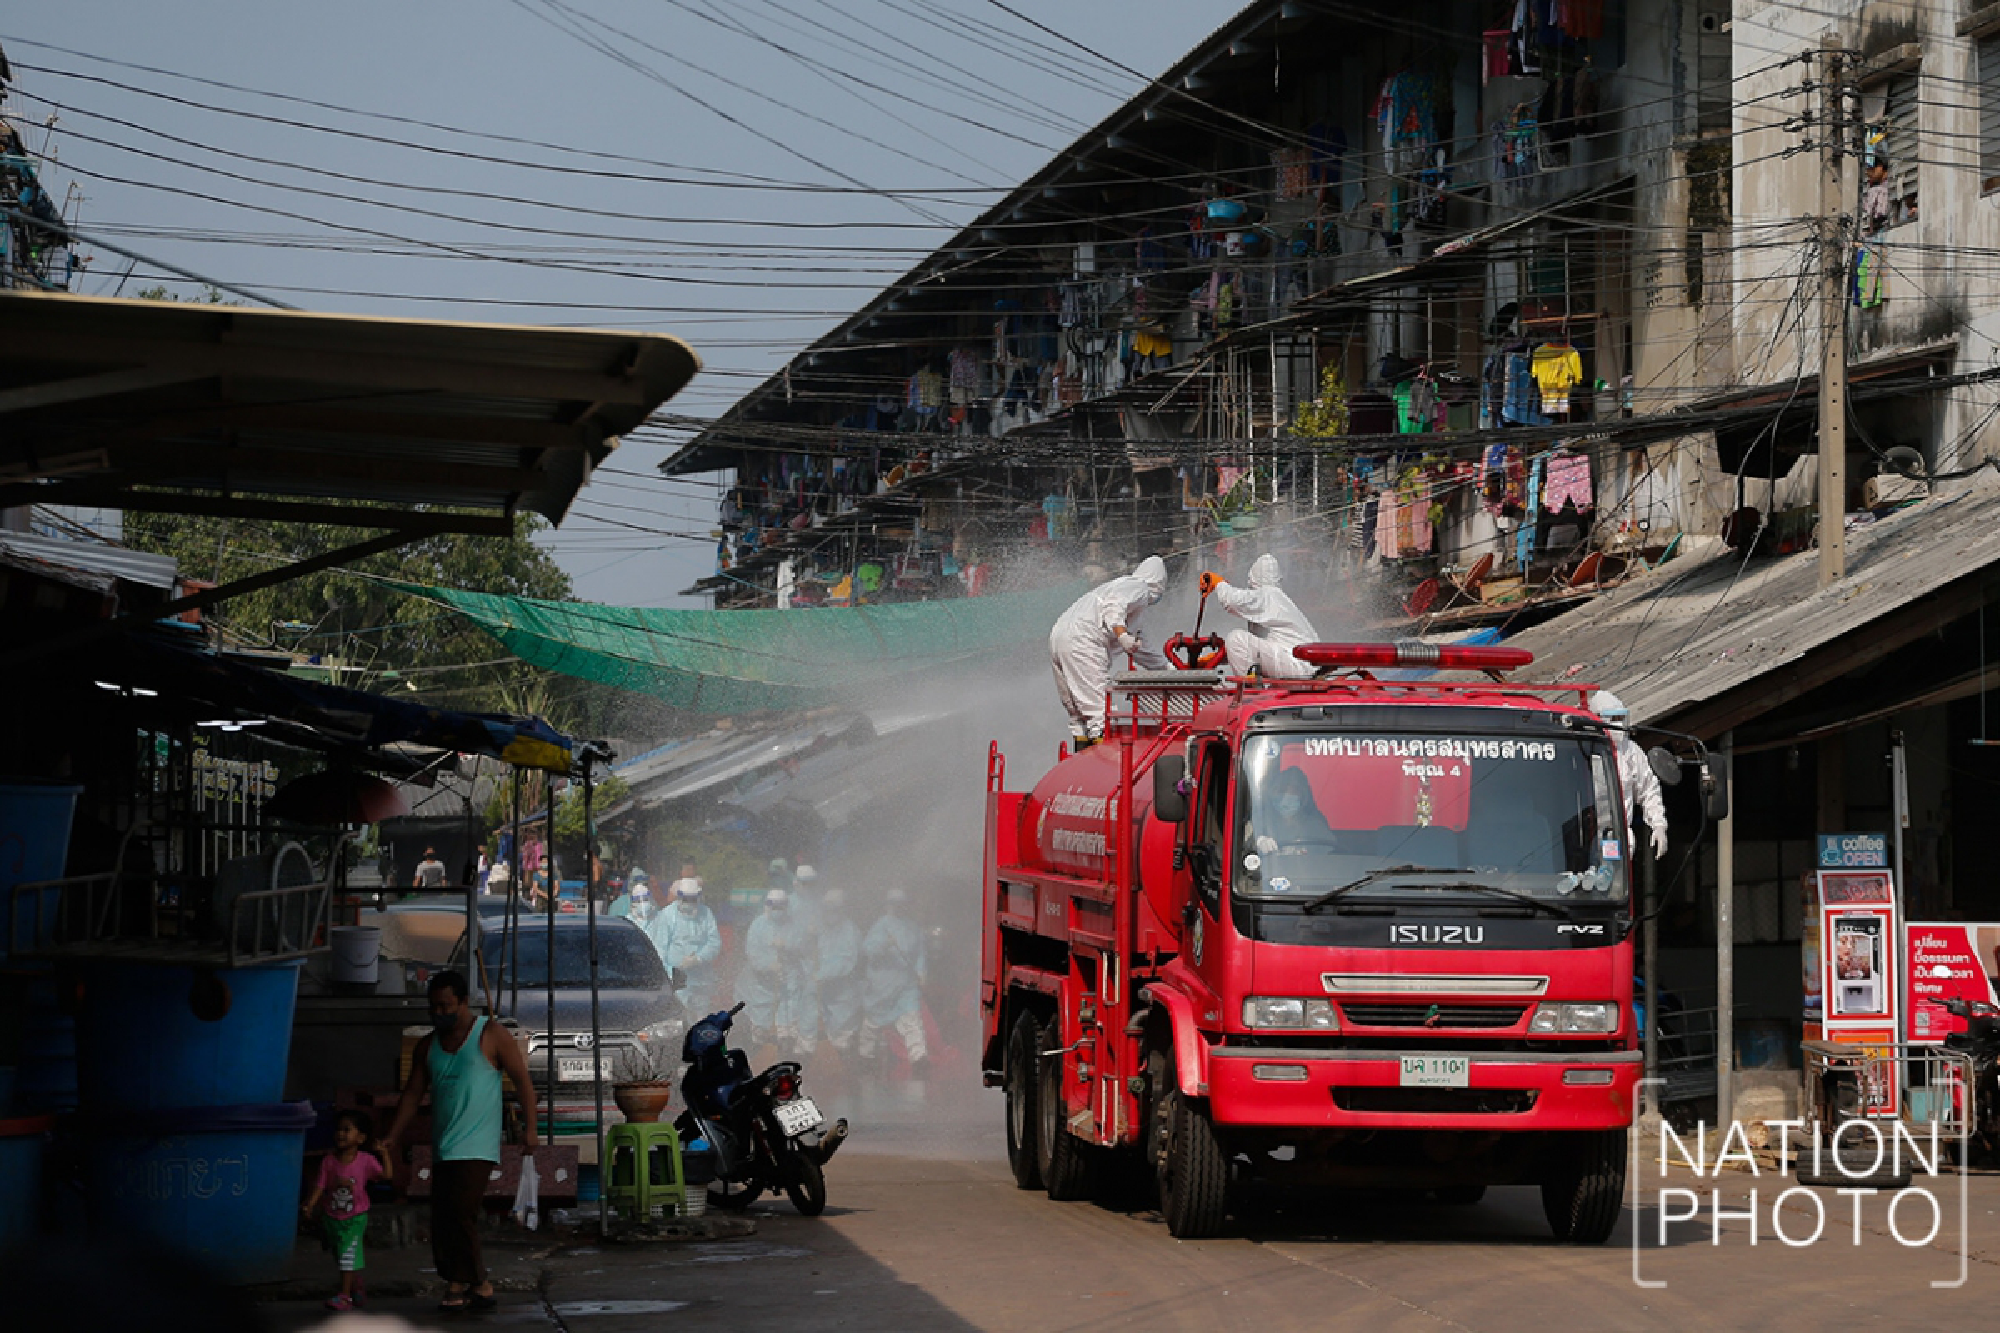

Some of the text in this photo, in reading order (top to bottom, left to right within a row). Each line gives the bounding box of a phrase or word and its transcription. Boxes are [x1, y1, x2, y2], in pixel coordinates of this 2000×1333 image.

[1305, 737, 1556, 766] เทศบาลนครสมุทรสาคร
[1450, 765, 1461, 776] 4
[1842, 835, 1883, 850] coffee
[1843, 852, 1882, 866] OPEN
[1390, 924, 1604, 943] ISUZU FVZ
[1433, 1060, 1466, 1073] 1101
